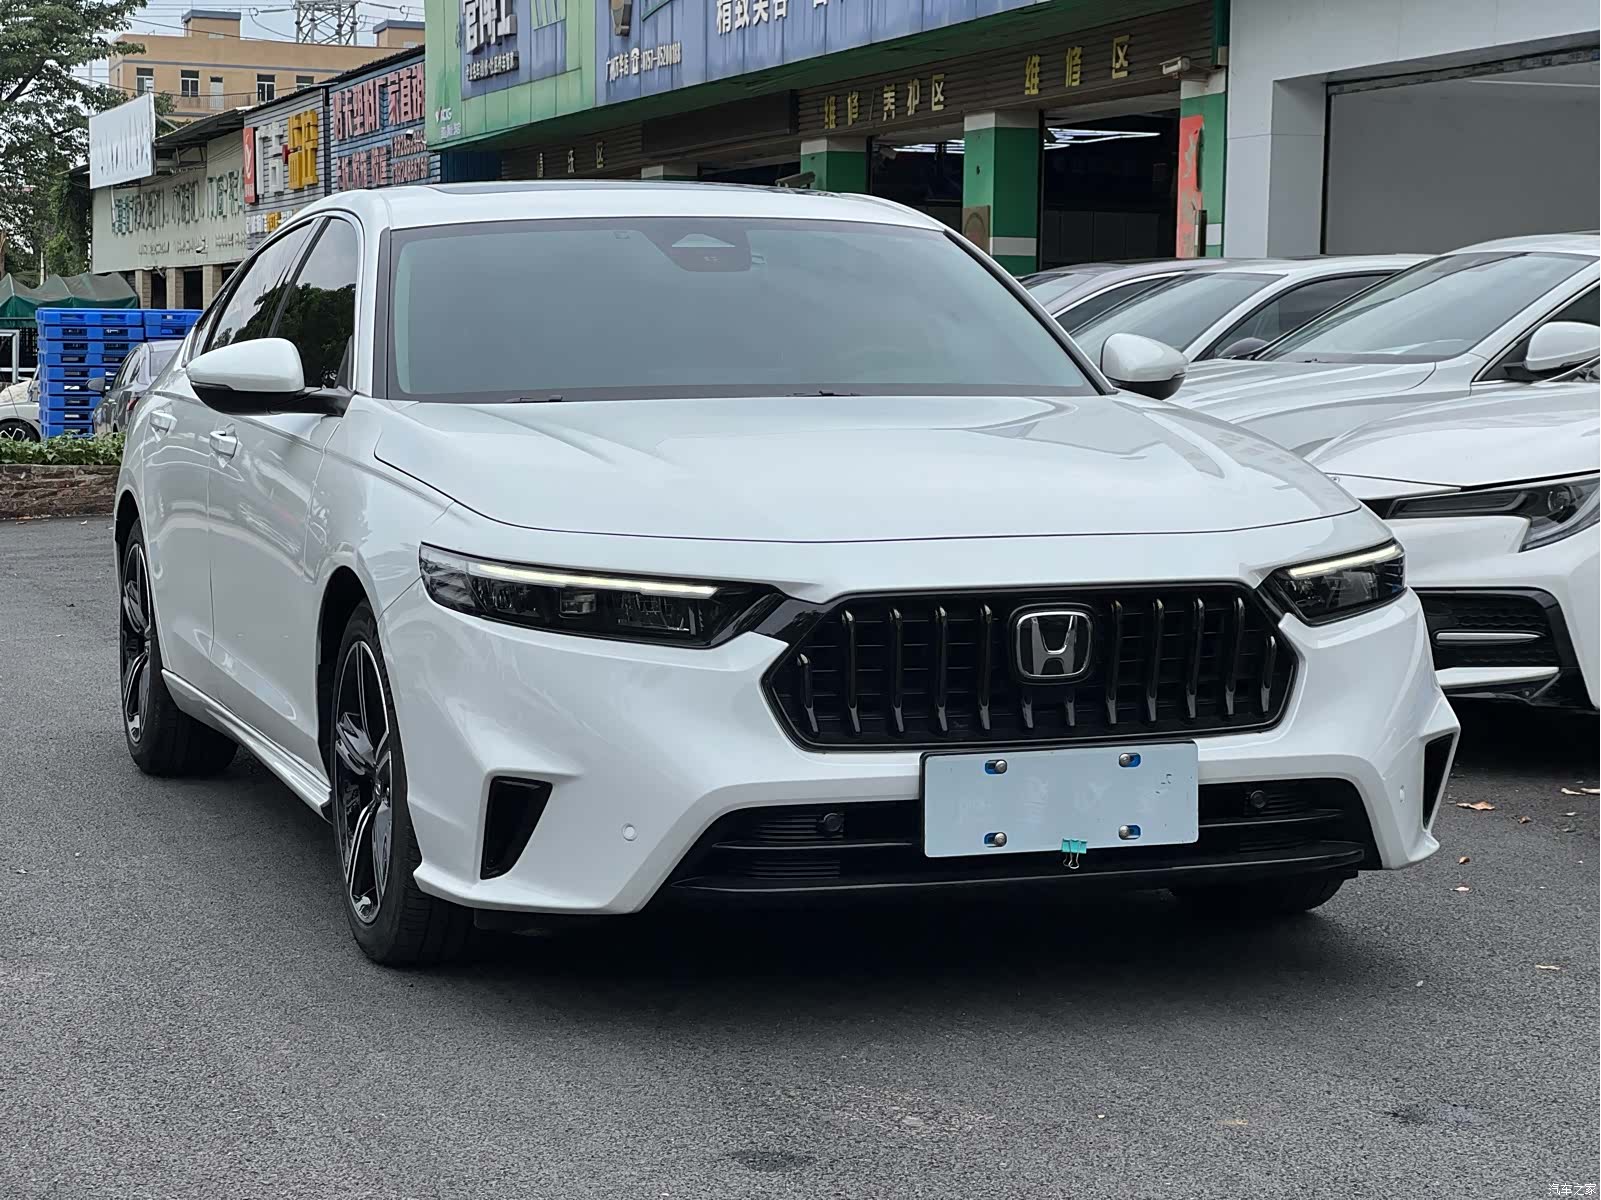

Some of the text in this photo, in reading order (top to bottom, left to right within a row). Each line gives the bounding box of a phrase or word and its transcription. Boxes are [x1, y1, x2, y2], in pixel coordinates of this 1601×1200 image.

[1024, 34, 1129, 95] 维修区
[824, 74, 945, 129] 维修/养护区
